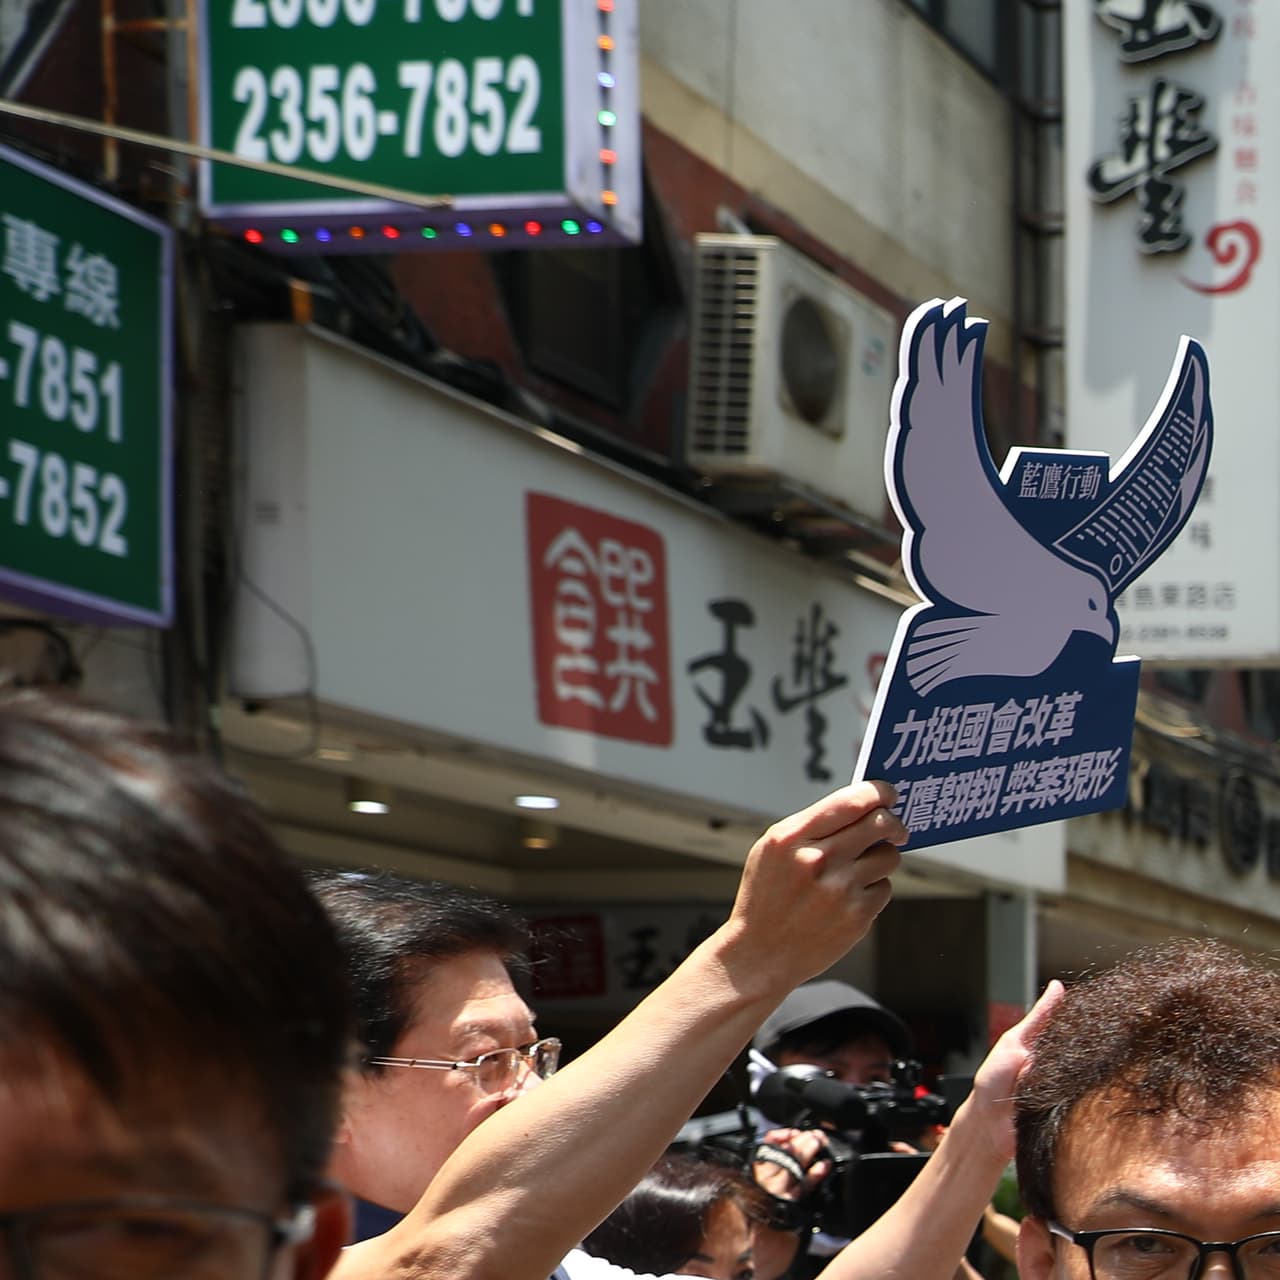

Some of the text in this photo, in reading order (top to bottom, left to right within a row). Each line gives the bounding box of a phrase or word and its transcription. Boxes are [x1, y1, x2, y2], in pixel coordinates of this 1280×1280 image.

[233, 55, 541, 163] 2356-7852
[1, 212, 120, 328] 專線
[1018, 462, 1102, 500] 藍鷹行動
[883, 691, 1083, 770] 力挺國會改革
[1000, 747, 1123, 816] 弊案現形
